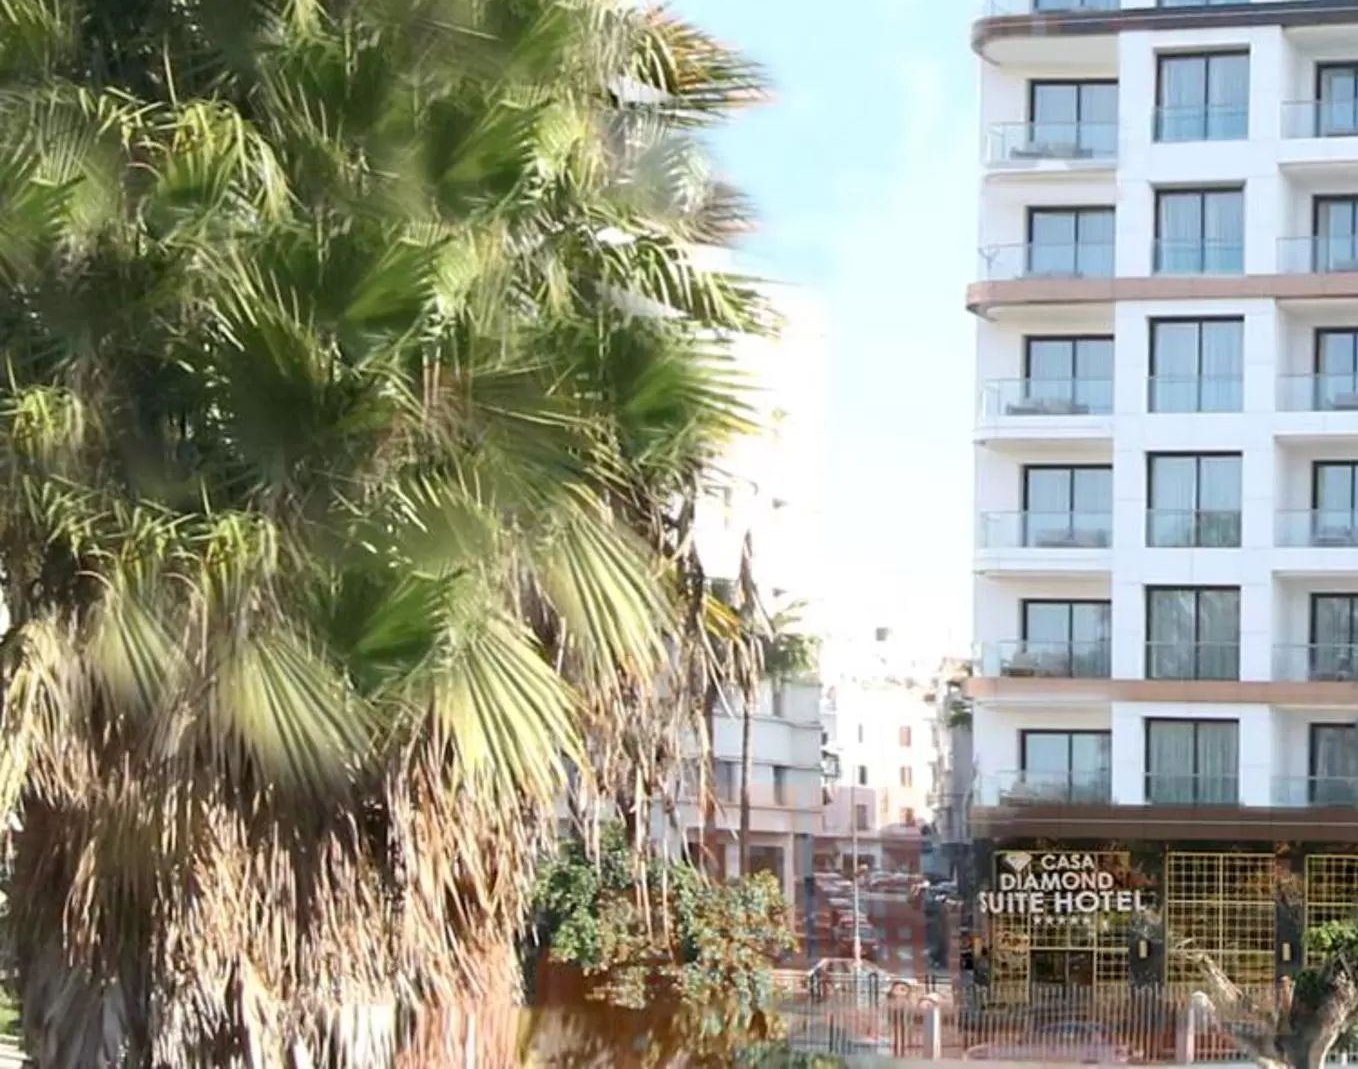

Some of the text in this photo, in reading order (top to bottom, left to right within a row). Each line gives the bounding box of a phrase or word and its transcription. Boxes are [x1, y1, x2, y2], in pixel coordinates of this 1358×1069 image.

[1041, 854, 1095, 870] CASA
[1001, 872, 1114, 890] DIAMOND
[980, 889, 1147, 913] SUITE HOTEL
